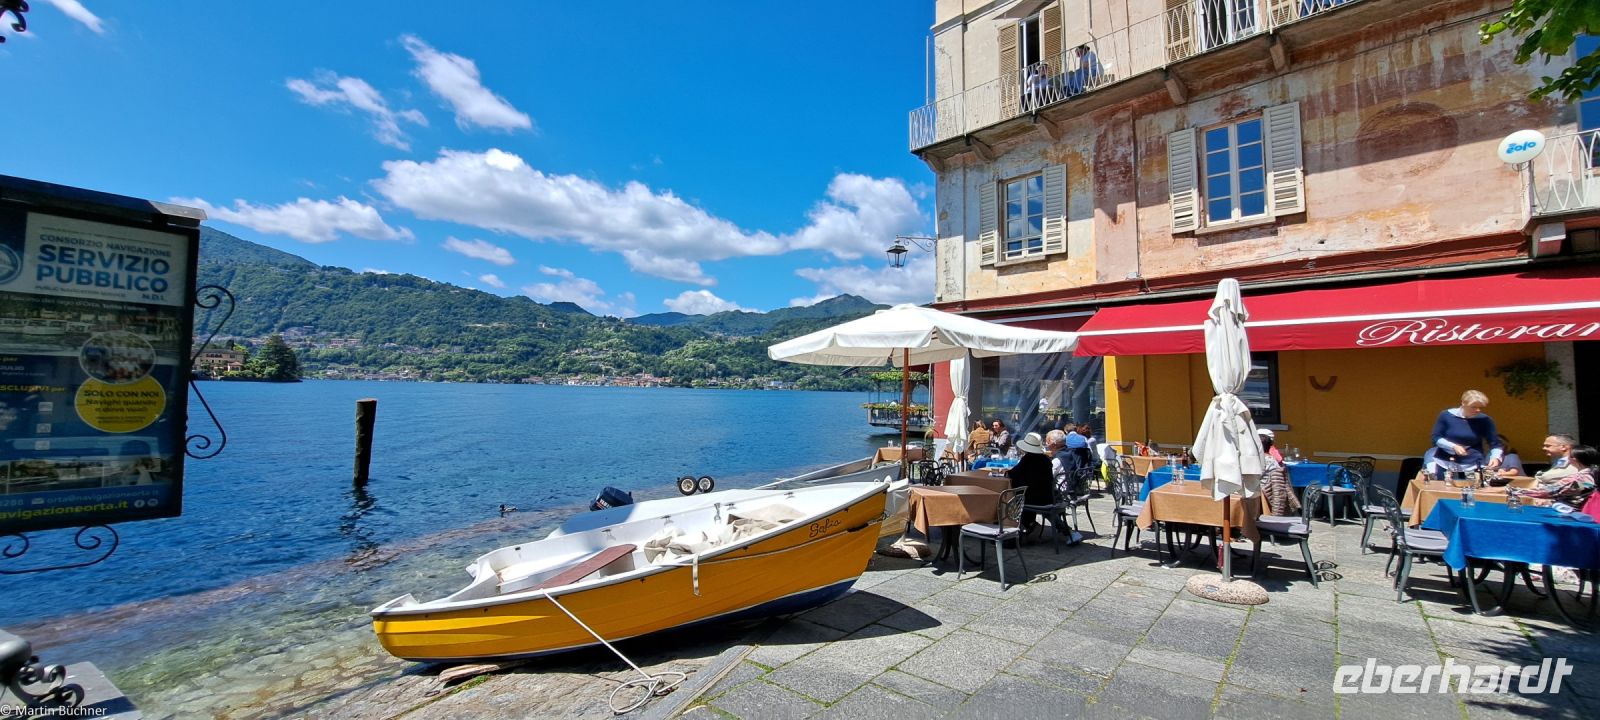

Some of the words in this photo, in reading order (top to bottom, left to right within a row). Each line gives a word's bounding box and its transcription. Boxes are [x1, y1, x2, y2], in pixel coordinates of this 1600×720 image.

[37, 243, 170, 275] SERVIZIO
[40, 234, 103, 249] CONSORZIO
[106, 243, 171, 258] NAVIGAZIONE
[36, 264, 168, 293] PUBBLICO
[84, 390, 114, 398] SOLO
[116, 390, 138, 398] CON
[141, 390, 160, 398] NOI
